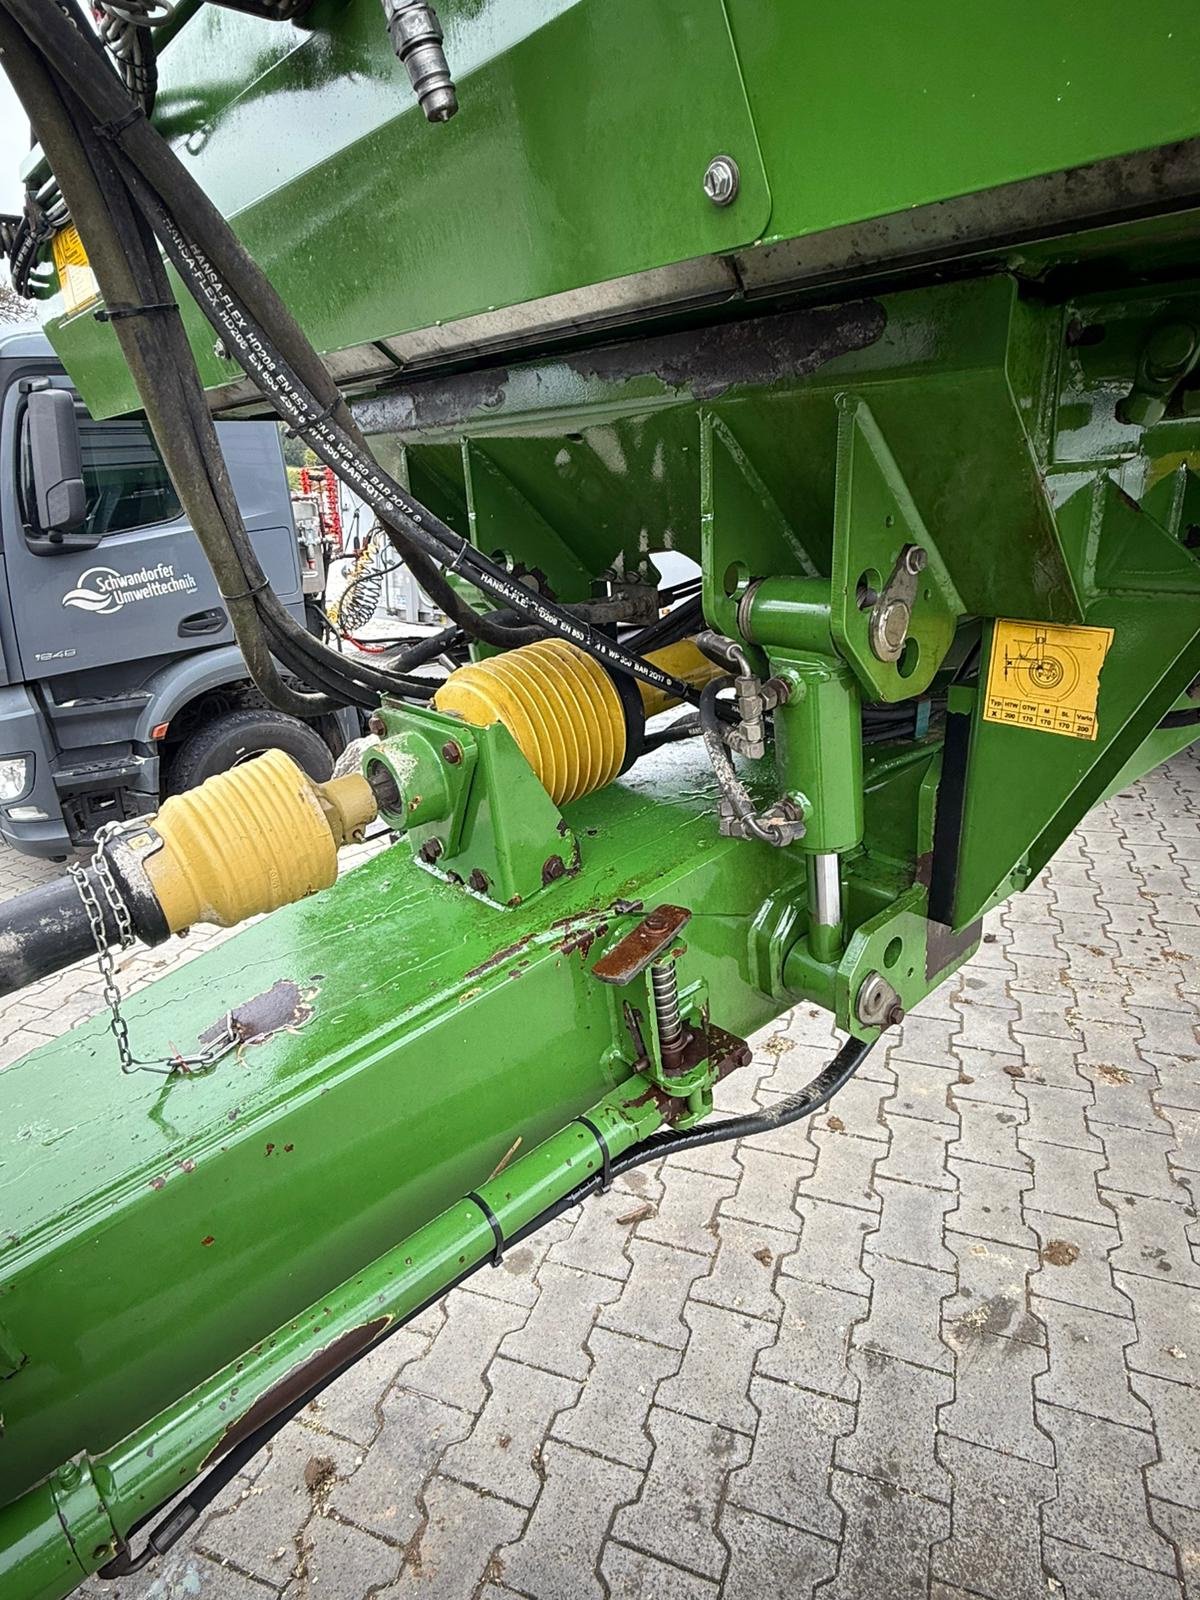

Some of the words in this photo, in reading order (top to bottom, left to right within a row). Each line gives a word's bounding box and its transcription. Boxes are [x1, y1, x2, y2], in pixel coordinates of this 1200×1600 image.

[190, 243, 247, 328] HANSA-FLEX
[246, 332, 276, 371] HD208
[276, 374, 293, 392] EN
[290, 392, 308, 412] 853
[326, 434, 336, 442] 8
[337, 442, 354, 459] WP
[351, 459, 369, 476] 350
[370, 476, 391, 496] BAR
[341, 460, 362, 482] BAR
[96, 563, 174, 592] Schwandorfer
[113, 573, 197, 605] Umwelttechnik
[560, 622, 572, 634] EN
[634, 663, 649, 675] BAR
[1040, 718, 1051, 726] 170
[1077, 725, 1089, 733] 200
[1077, 713, 1093, 722] Vario
